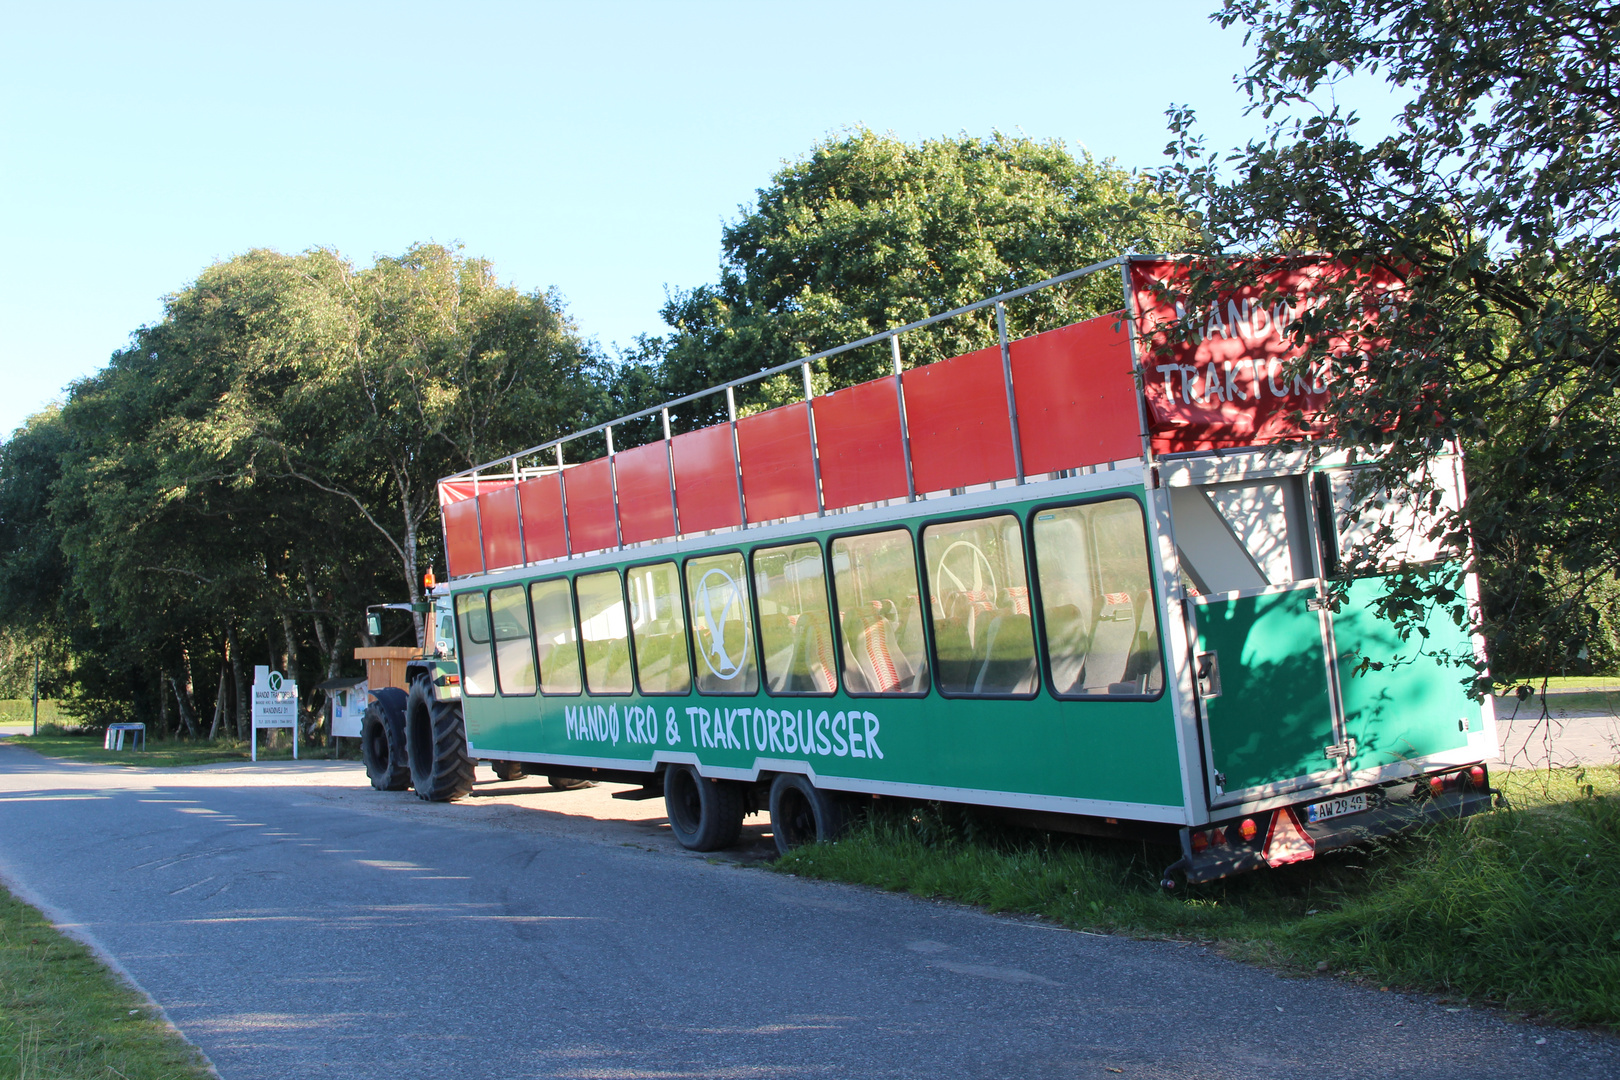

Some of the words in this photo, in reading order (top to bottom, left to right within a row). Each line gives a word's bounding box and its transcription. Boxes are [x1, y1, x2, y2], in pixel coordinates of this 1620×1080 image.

[1155, 351, 1368, 405] TRAKTORB
[565, 702, 620, 747] MANDØ
[624, 705, 658, 745] KRO
[665, 706, 681, 746] &
[685, 706, 884, 760] TRAKTORBUSSER
[1319, 802, 1333, 818] AW
[1335, 799, 1348, 814] 29
